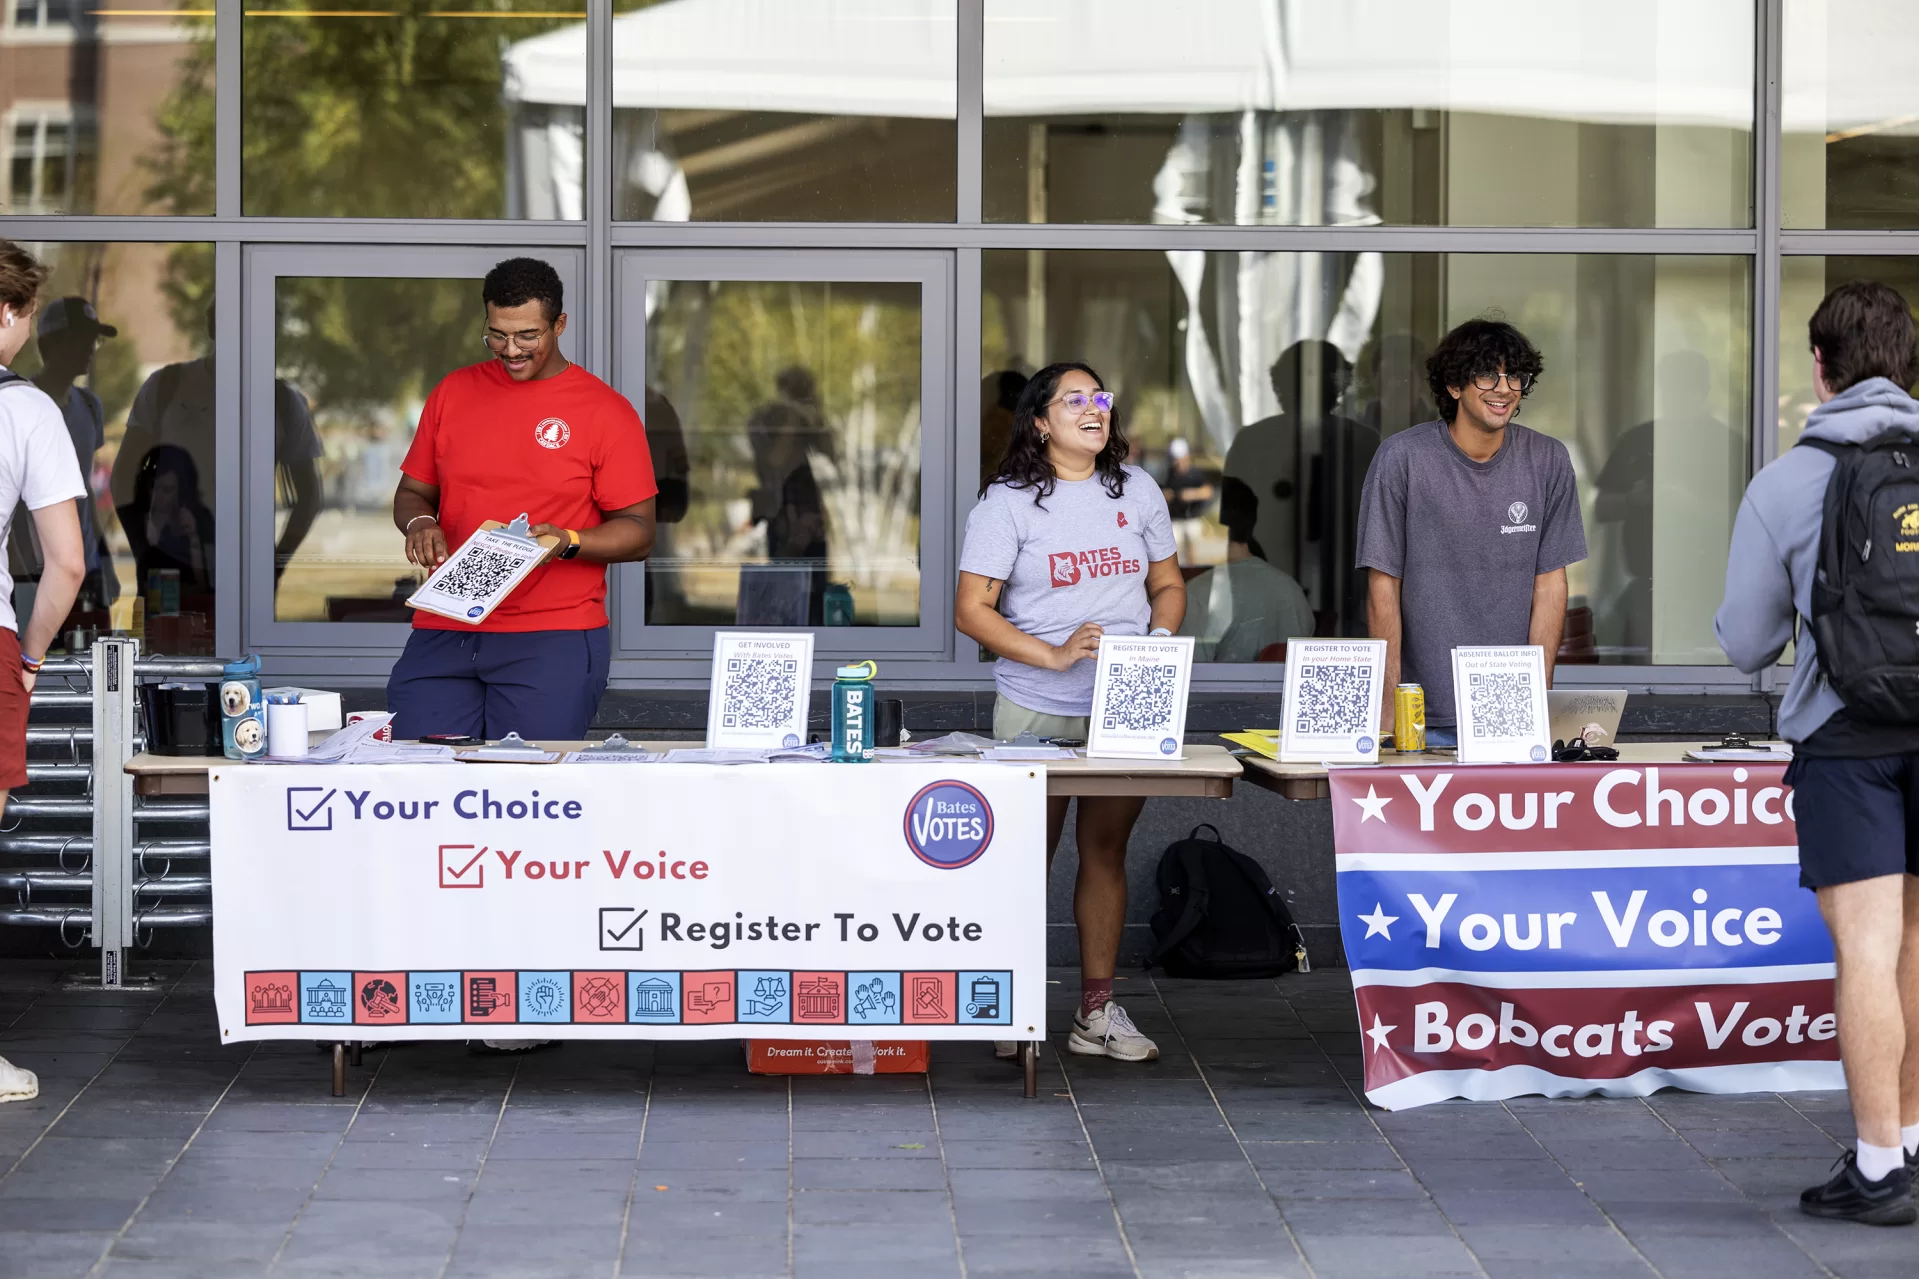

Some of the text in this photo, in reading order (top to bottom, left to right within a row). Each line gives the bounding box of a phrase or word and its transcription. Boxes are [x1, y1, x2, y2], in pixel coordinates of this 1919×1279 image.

[485, 536, 500, 544] TAKE
[512, 543, 536, 553] PLEDGE
[1087, 559, 1140, 578] VOTES
[738, 641, 752, 649] GET
[1113, 644, 1146, 652] REGISTER
[1493, 650, 1519, 658] BALLOT
[1508, 661, 1532, 669] Voting
[846, 690, 863, 754] BATES
[344, 788, 583, 820] Your Choice
[937, 801, 976, 814] Bates
[1400, 771, 1576, 832] Your
[913, 797, 984, 846] VOTES
[495, 850, 709, 880] Your Voice
[660, 912, 983, 950] Register To Vote
[1407, 888, 1784, 952] Your Voice
[1413, 1001, 1837, 1058] Bobcats Vote
[767, 1047, 803, 1057] Dream
[804, 1047, 814, 1057] it.
[816, 1046, 852, 1057] Create
[896, 1047, 906, 1056] it.
